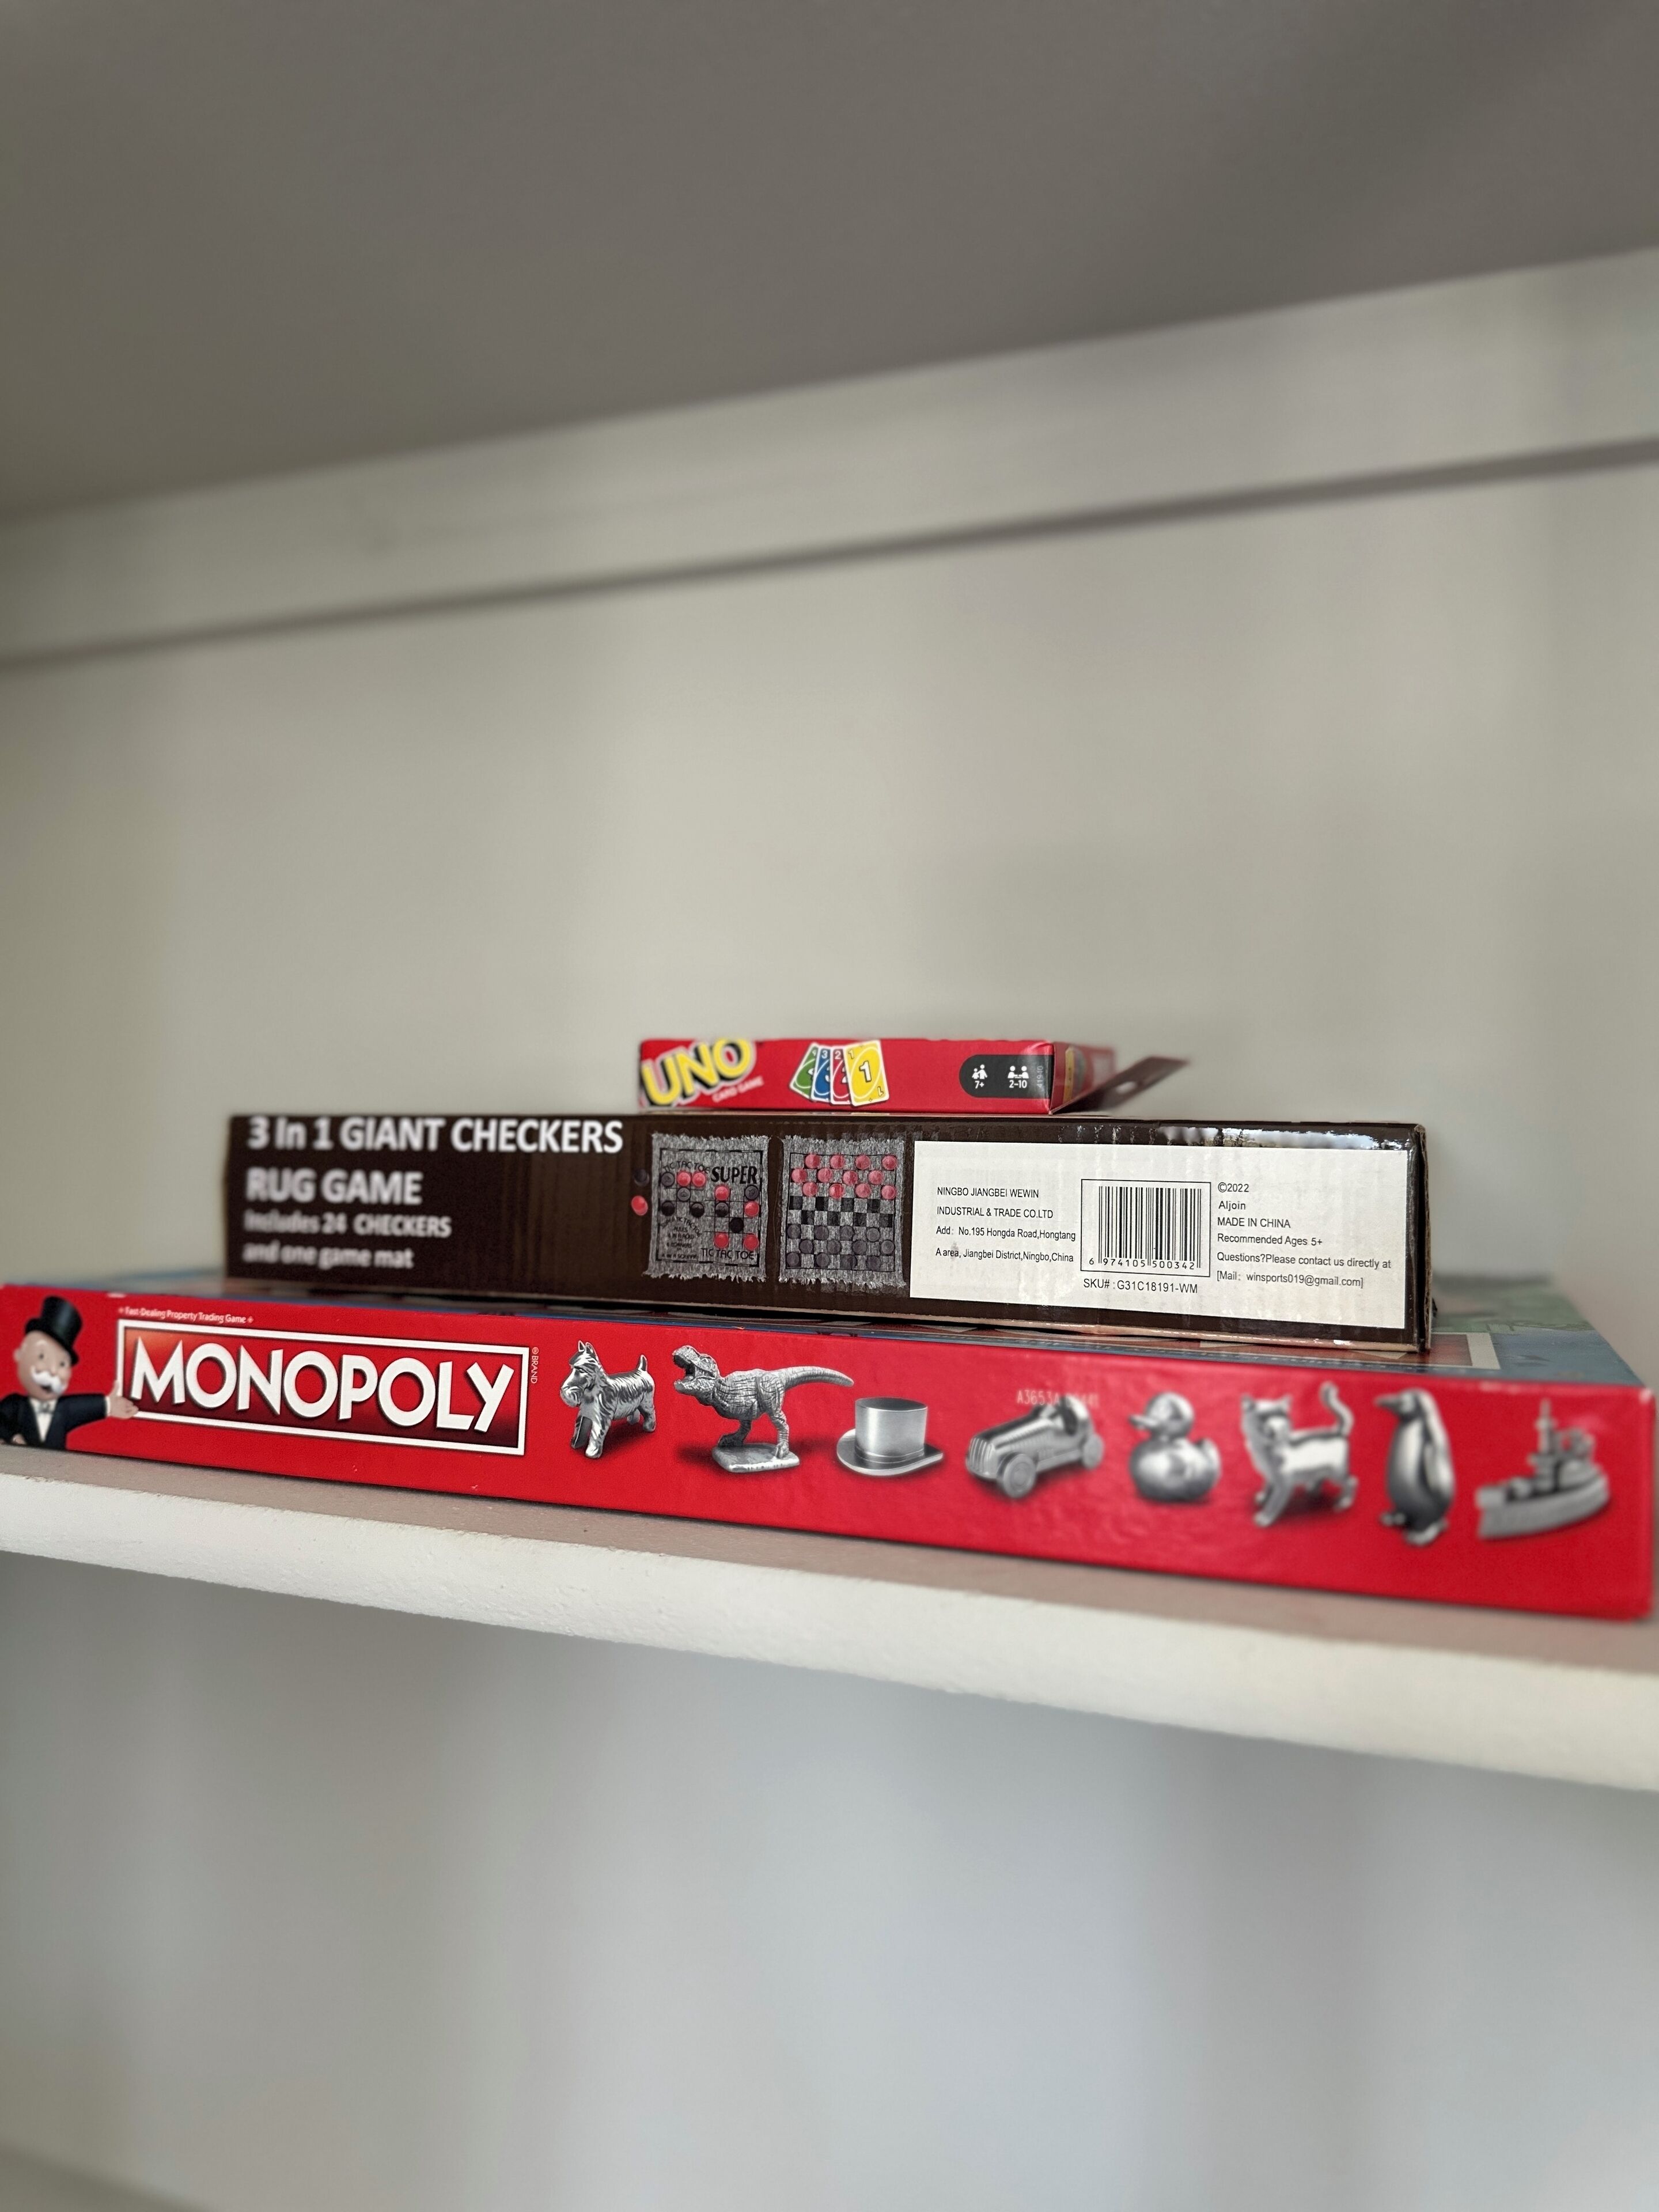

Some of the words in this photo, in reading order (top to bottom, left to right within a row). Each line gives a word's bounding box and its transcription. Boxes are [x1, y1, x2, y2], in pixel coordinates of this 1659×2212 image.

[821, 1050, 828, 1059] 3
[835, 1051, 842, 1060] 2
[848, 1050, 855, 1059] 1
[641, 1038, 752, 1105] UNO
[859, 1060, 872, 1083] 1
[975, 1081, 984, 1089] 7+
[248, 1116, 270, 1149] 3
[313, 1118, 333, 1150] 1
[340, 1117, 445, 1151] GIANT
[450, 1118, 623, 1153] CHECKERS
[710, 1165, 757, 1184] SUPER
[246, 1167, 316, 1203] RUG
[321, 1169, 423, 1205] GAME
[937, 1187, 968, 1196] NINGBO
[971, 1187, 1007, 1197] JIANGBEI
[1010, 1188, 1039, 1198] WEWIN
[1218, 1200, 1245, 1211] Aljoin
[937, 1206, 984, 1216] INDUSTRIAL
[986, 1208, 991, 1216] &
[994, 1208, 1021, 1217] TRADE
[1024, 1209, 1053, 1218] CO.LTD
[322, 1212, 347, 1234] 24
[353, 1213, 452, 1237] CHECKERS
[1217, 1217, 1245, 1226] MADE
[1248, 1218, 1257, 1227] IN
[1260, 1218, 1291, 1228] CHINA
[959, 1227, 984, 1236] No.195
[987, 1228, 1015, 1239] Hongda
[1217, 1233, 1282, 1244] Recommended
[1285, 1236, 1308, 1247] Ages
[1311, 1237, 1323, 1245] 5+
[243, 1240, 280, 1263] and
[281, 1245, 317, 1265] one
[319, 1248, 372, 1270] game
[374, 1249, 414, 1269] mat
[701, 1248, 714, 1257] TIC
[716, 1249, 733, 1259] TAC
[736, 1251, 754, 1260] TOE
[963, 1249, 994, 1260] Jiangbei
[1298, 1256, 1331, 1266] contact
[1347, 1257, 1379, 1270] directly
[1382, 1259, 1391, 1268] at
[167, 1310, 197, 1321] Property
[199, 1312, 224, 1323] Trading
[225, 1314, 246, 1323] Game
[130, 1336, 515, 1433] MONOPOLY
